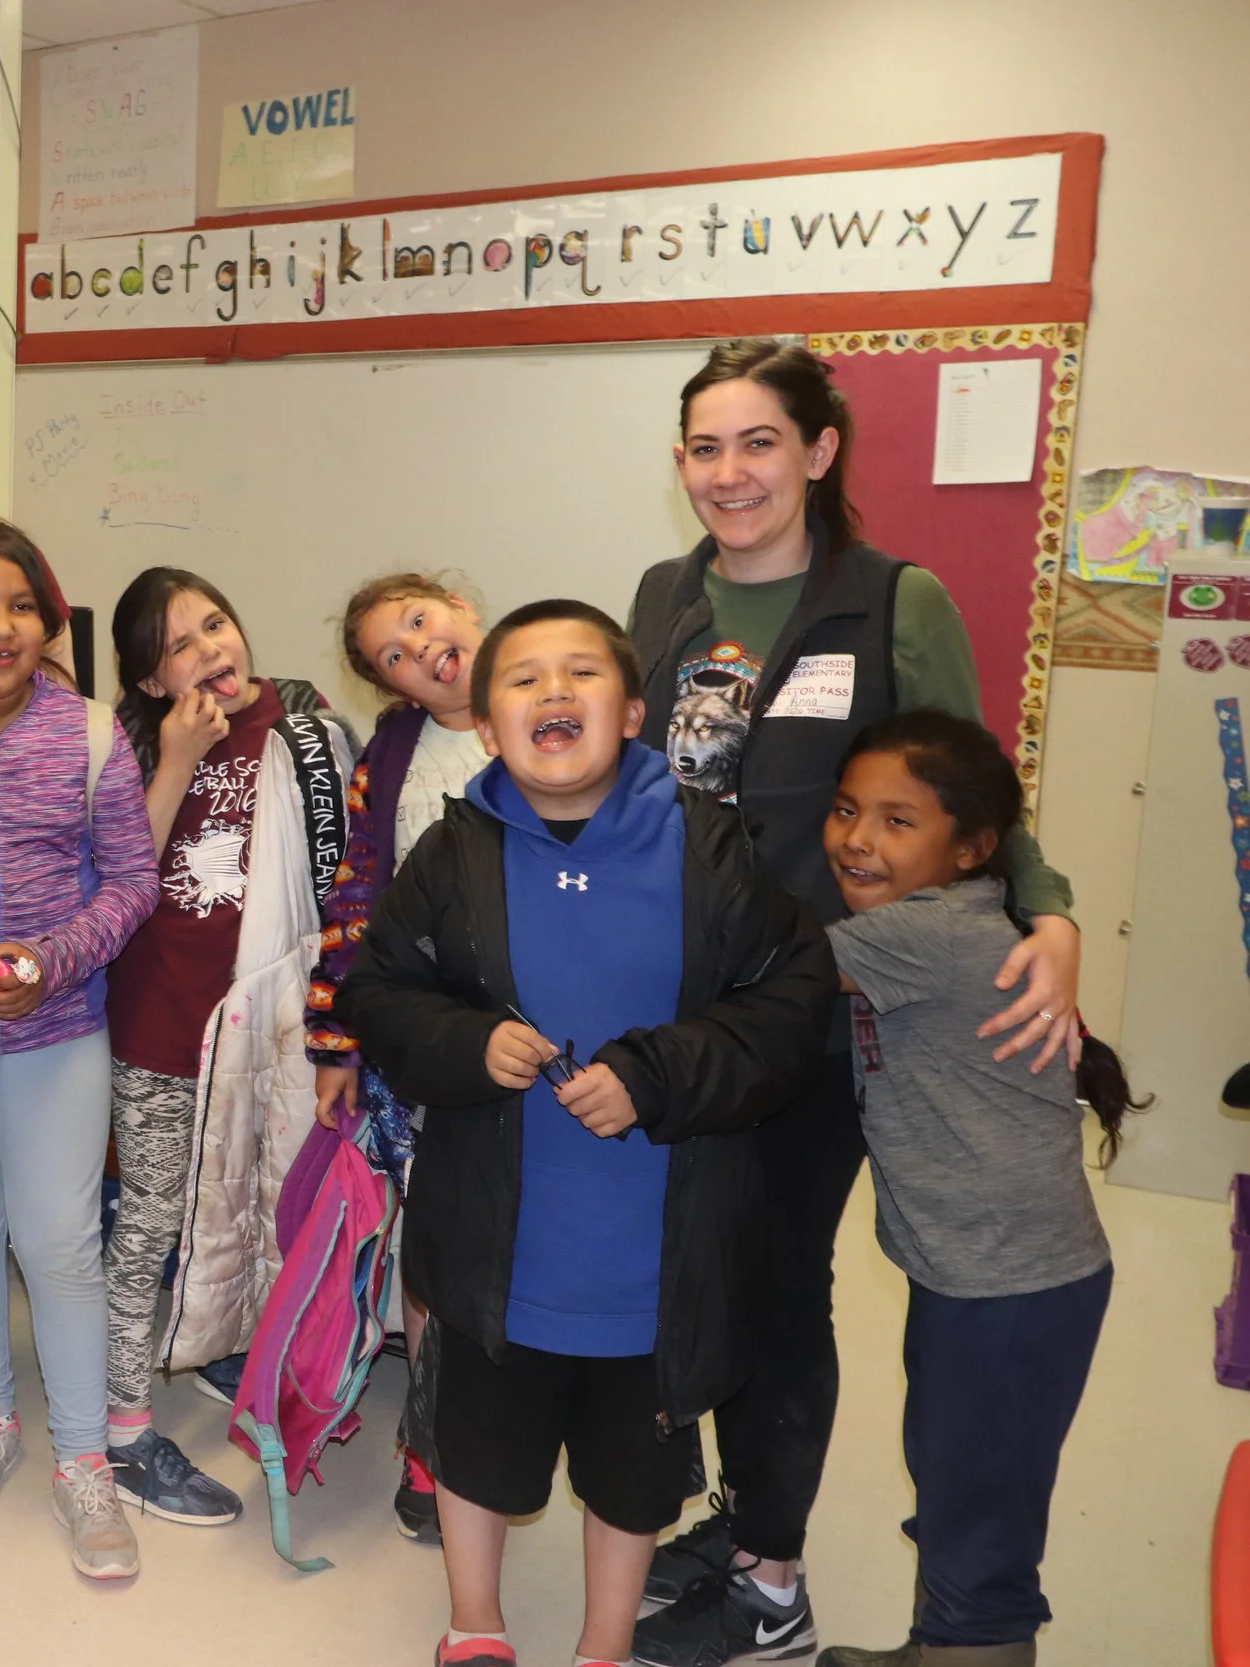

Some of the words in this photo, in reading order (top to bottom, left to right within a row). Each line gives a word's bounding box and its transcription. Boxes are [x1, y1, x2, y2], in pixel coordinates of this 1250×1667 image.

[241, 87, 356, 136] VOWEL
[98, 394, 166, 418] Inside
[171, 390, 207, 414] Out
[792, 669, 853, 678] ELEMENTARY
[820, 686, 850, 697] PASS
[209, 788, 258, 816] 2016
[307, 768, 336, 834] KLEIN
